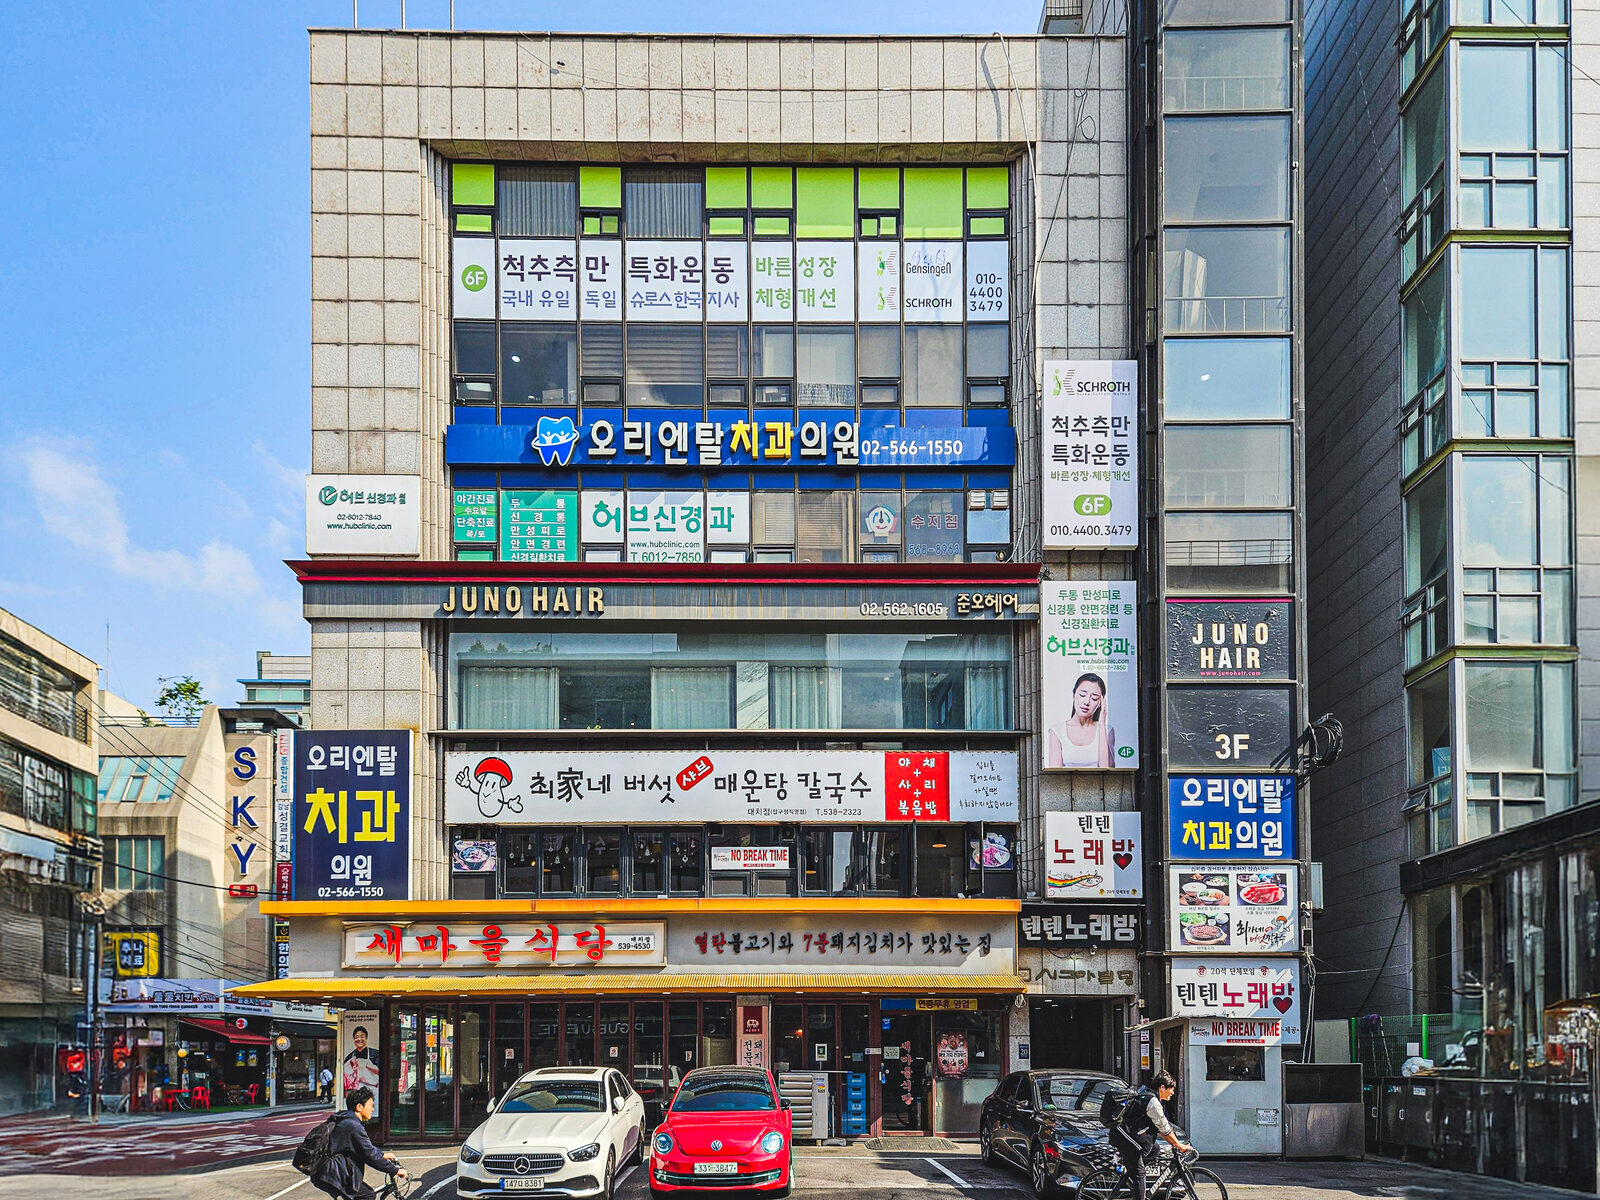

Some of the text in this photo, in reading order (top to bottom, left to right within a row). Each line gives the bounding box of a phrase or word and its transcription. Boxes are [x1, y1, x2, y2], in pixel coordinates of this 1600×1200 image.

[502, 254, 735, 285] 척추측만 특화운동
[464, 273, 485, 286] 6F
[975, 273, 1002, 285] 010-
[501, 290, 533, 307] 국내
[538, 290, 570, 308] 유일
[584, 290, 617, 308] 독일
[970, 286, 1003, 298] 4400
[905, 298, 952, 308] SCHROTH
[970, 299, 1003, 312] 3479
[1077, 381, 1130, 393] SCHROTH
[1051, 415, 1131, 438] 척추측만
[861, 440, 963, 457] 02-566-1550
[1051, 444, 1130, 466] 특화운동
[456, 494, 495, 504] 야간진료
[1081, 497, 1105, 514] 6F
[464, 507, 487, 515] 수요일
[592, 500, 735, 533] 허브신경과
[1050, 525, 1132, 537] 010.4400.3479
[630, 541, 701, 549] www.hubclinic.com
[443, 586, 605, 613] JUNO HAIR
[957, 593, 1019, 615] 준오헤어
[1058, 590, 1122, 601] 두통 만성피로
[860, 602, 944, 616] 02.562.1605
[1047, 604, 1134, 616] 신경통 안면경련 등
[1061, 618, 1120, 630] 신경질환치료
[1192, 623, 1270, 645] JUNO
[1046, 634, 1130, 656] 허브신경과
[1201, 648, 1261, 669] HAIR
[1120, 747, 1132, 758] 4F
[1215, 734, 1250, 760] 3F
[306, 745, 398, 777] 오리엔탈
[624, 774, 676, 804] 버섯
[681, 759, 711, 788] 샤브
[714, 768, 790, 803] 매운탕
[797, 770, 872, 804] 칼국수
[1181, 777, 1284, 814] 오리엔탈
[303, 787, 401, 844] 치과
[815, 808, 862, 816] T.538-2323
[1077, 815, 1111, 834] 텐텐
[1181, 819, 1284, 857] 치과의원
[730, 849, 742, 862] NO
[743, 849, 768, 862] BREAK
[769, 849, 788, 862] TIME
[330, 855, 373, 886] 의원
[317, 887, 384, 897] 02-566-1550
[1020, 914, 1138, 942] 텐텐노래방
[366, 924, 614, 964] 새마을식당
[618, 942, 651, 950] 539-4530
[694, 931, 794, 954] 열탄불고기와
[921, 932, 971, 955] 맛있는
[977, 933, 991, 955] 집
[1211, 1022, 1225, 1037] NO
[1226, 1022, 1256, 1037] BREAK
[1256, 1022, 1280, 1037] TIME
[524, 1180, 542, 1188] 8381
